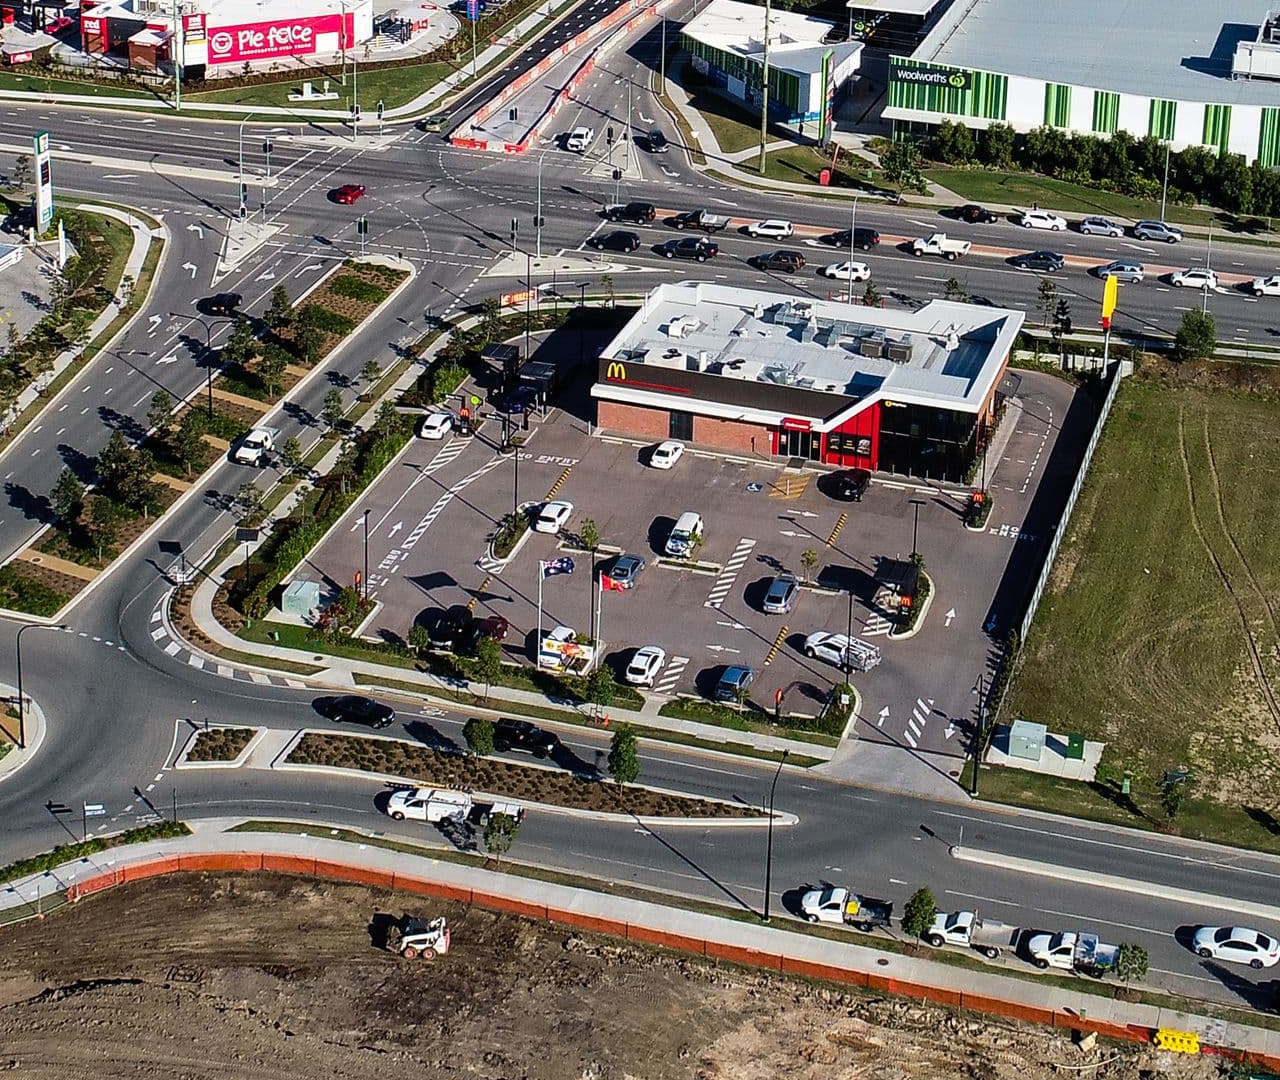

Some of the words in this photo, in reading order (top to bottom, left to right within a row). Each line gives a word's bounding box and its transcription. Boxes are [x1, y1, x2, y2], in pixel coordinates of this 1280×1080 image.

[237, 29, 264, 51] Pie
[266, 25, 312, 48] face
[897, 69, 947, 84] Woolworths
[538, 455, 580, 465] ENTRY
[1000, 524, 1020, 532] NO
